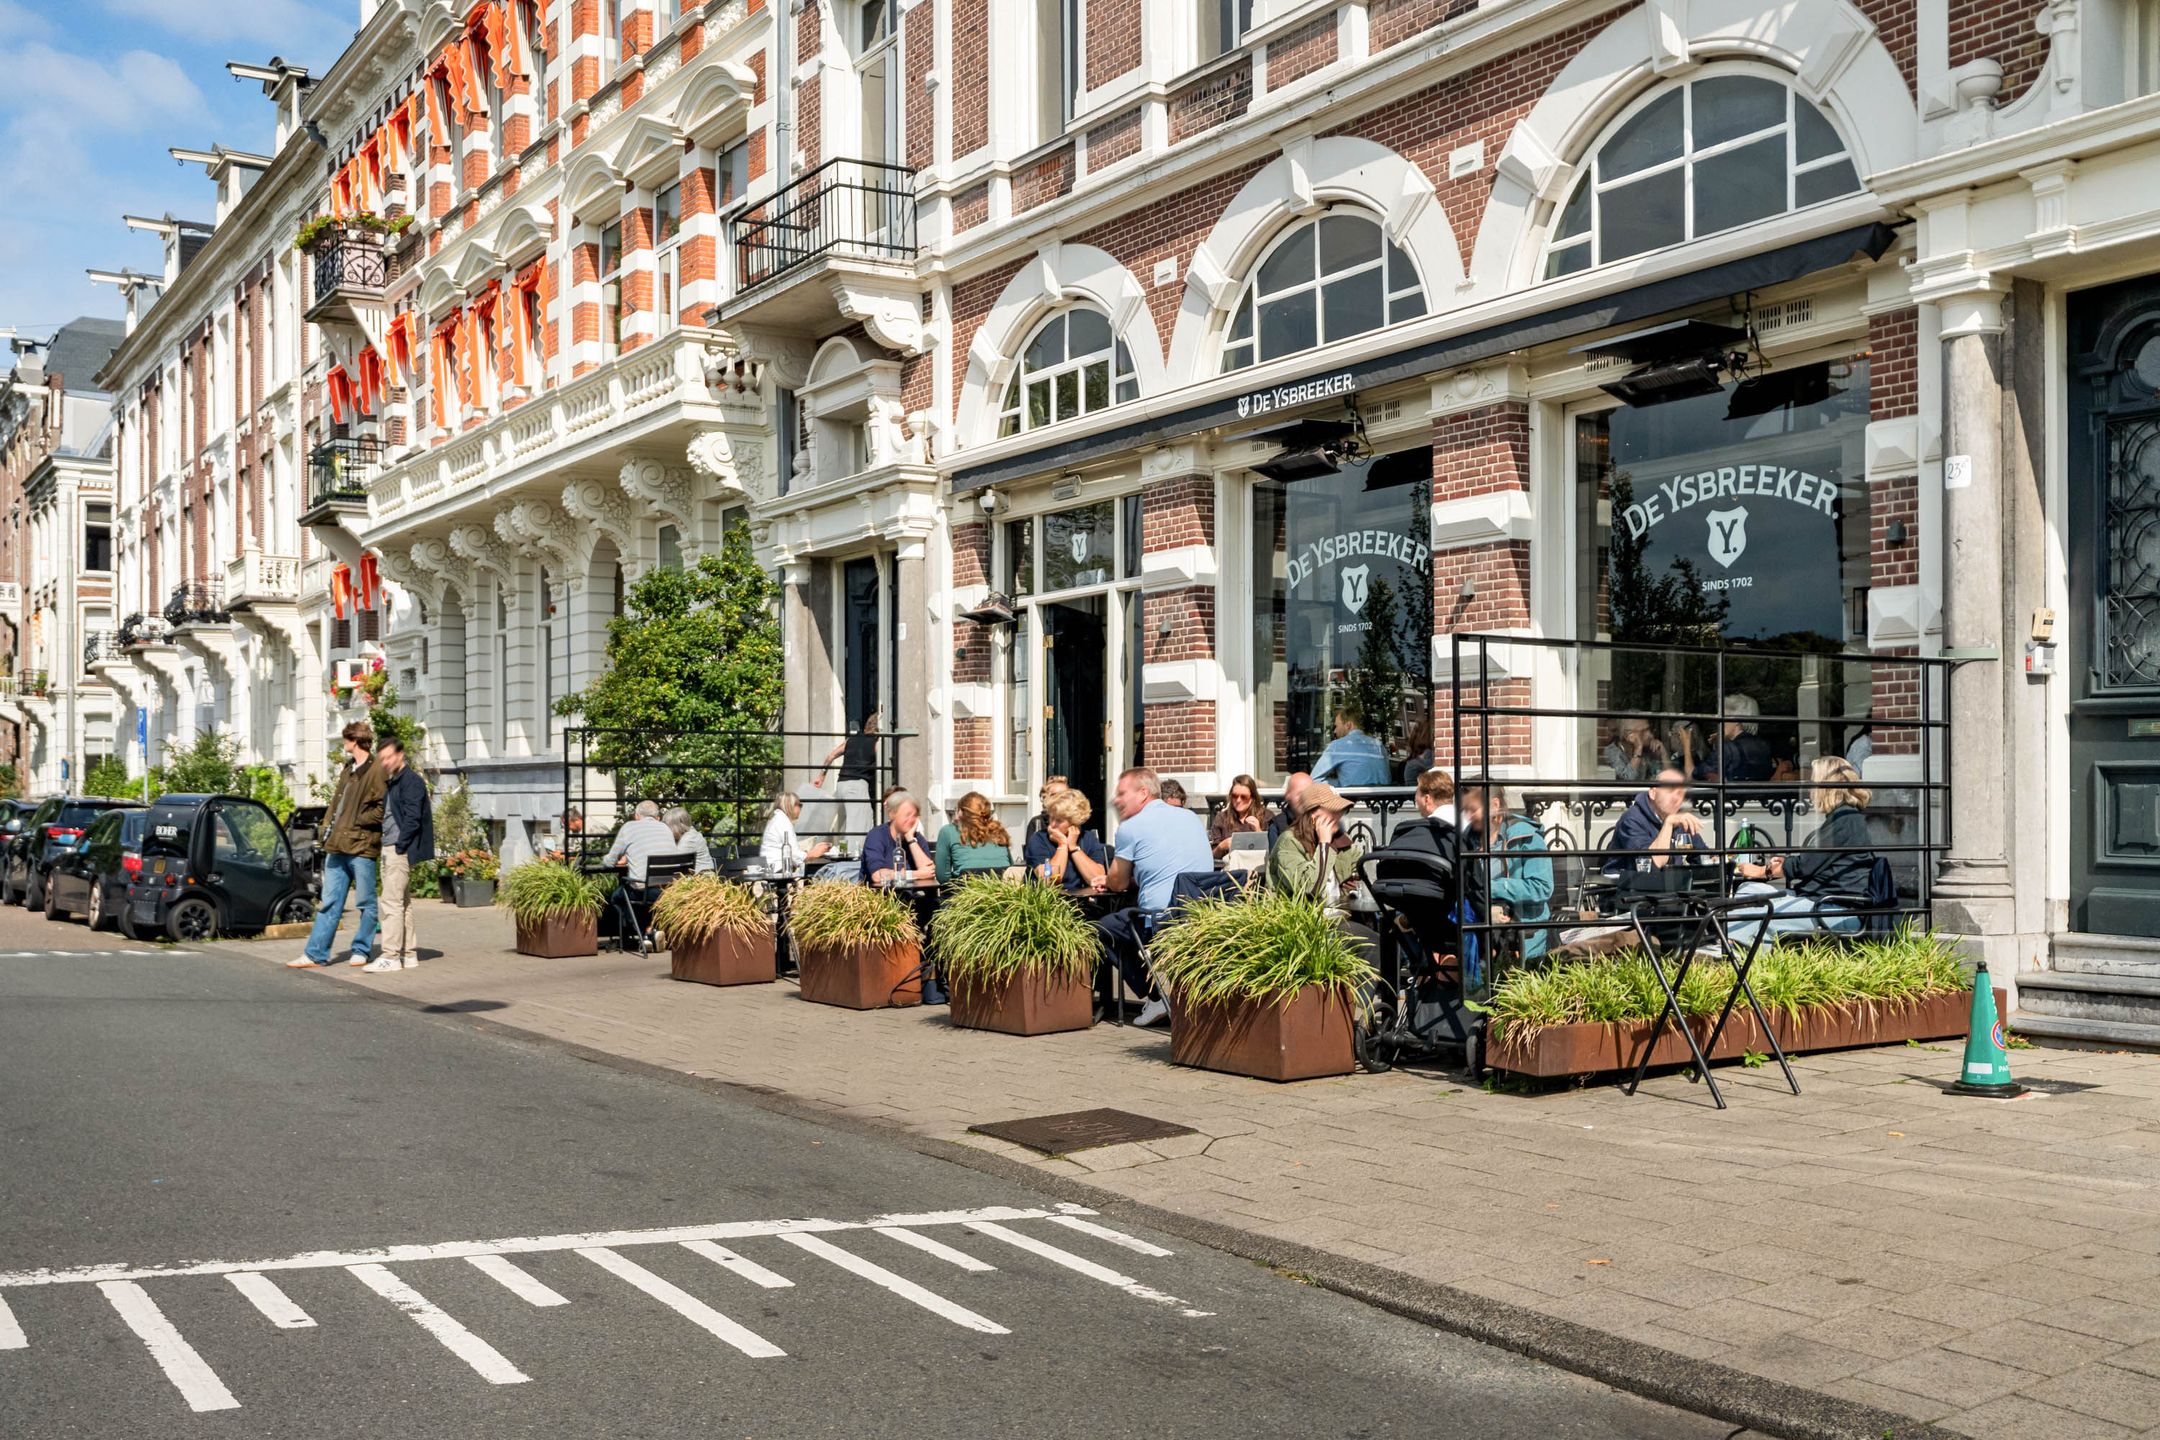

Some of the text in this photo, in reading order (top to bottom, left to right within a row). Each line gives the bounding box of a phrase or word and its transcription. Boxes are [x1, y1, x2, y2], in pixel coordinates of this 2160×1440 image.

[1253, 393, 1271, 414] DE
[1272, 373, 1356, 409] YSBREEKER.
[1622, 465, 1840, 541] DE YSBREEKER.
[1285, 530, 1429, 589] DE YSBREEKER.
[1701, 576, 1753, 592] SINDS 1702
[1338, 621, 1373, 634] SINDS 1702
